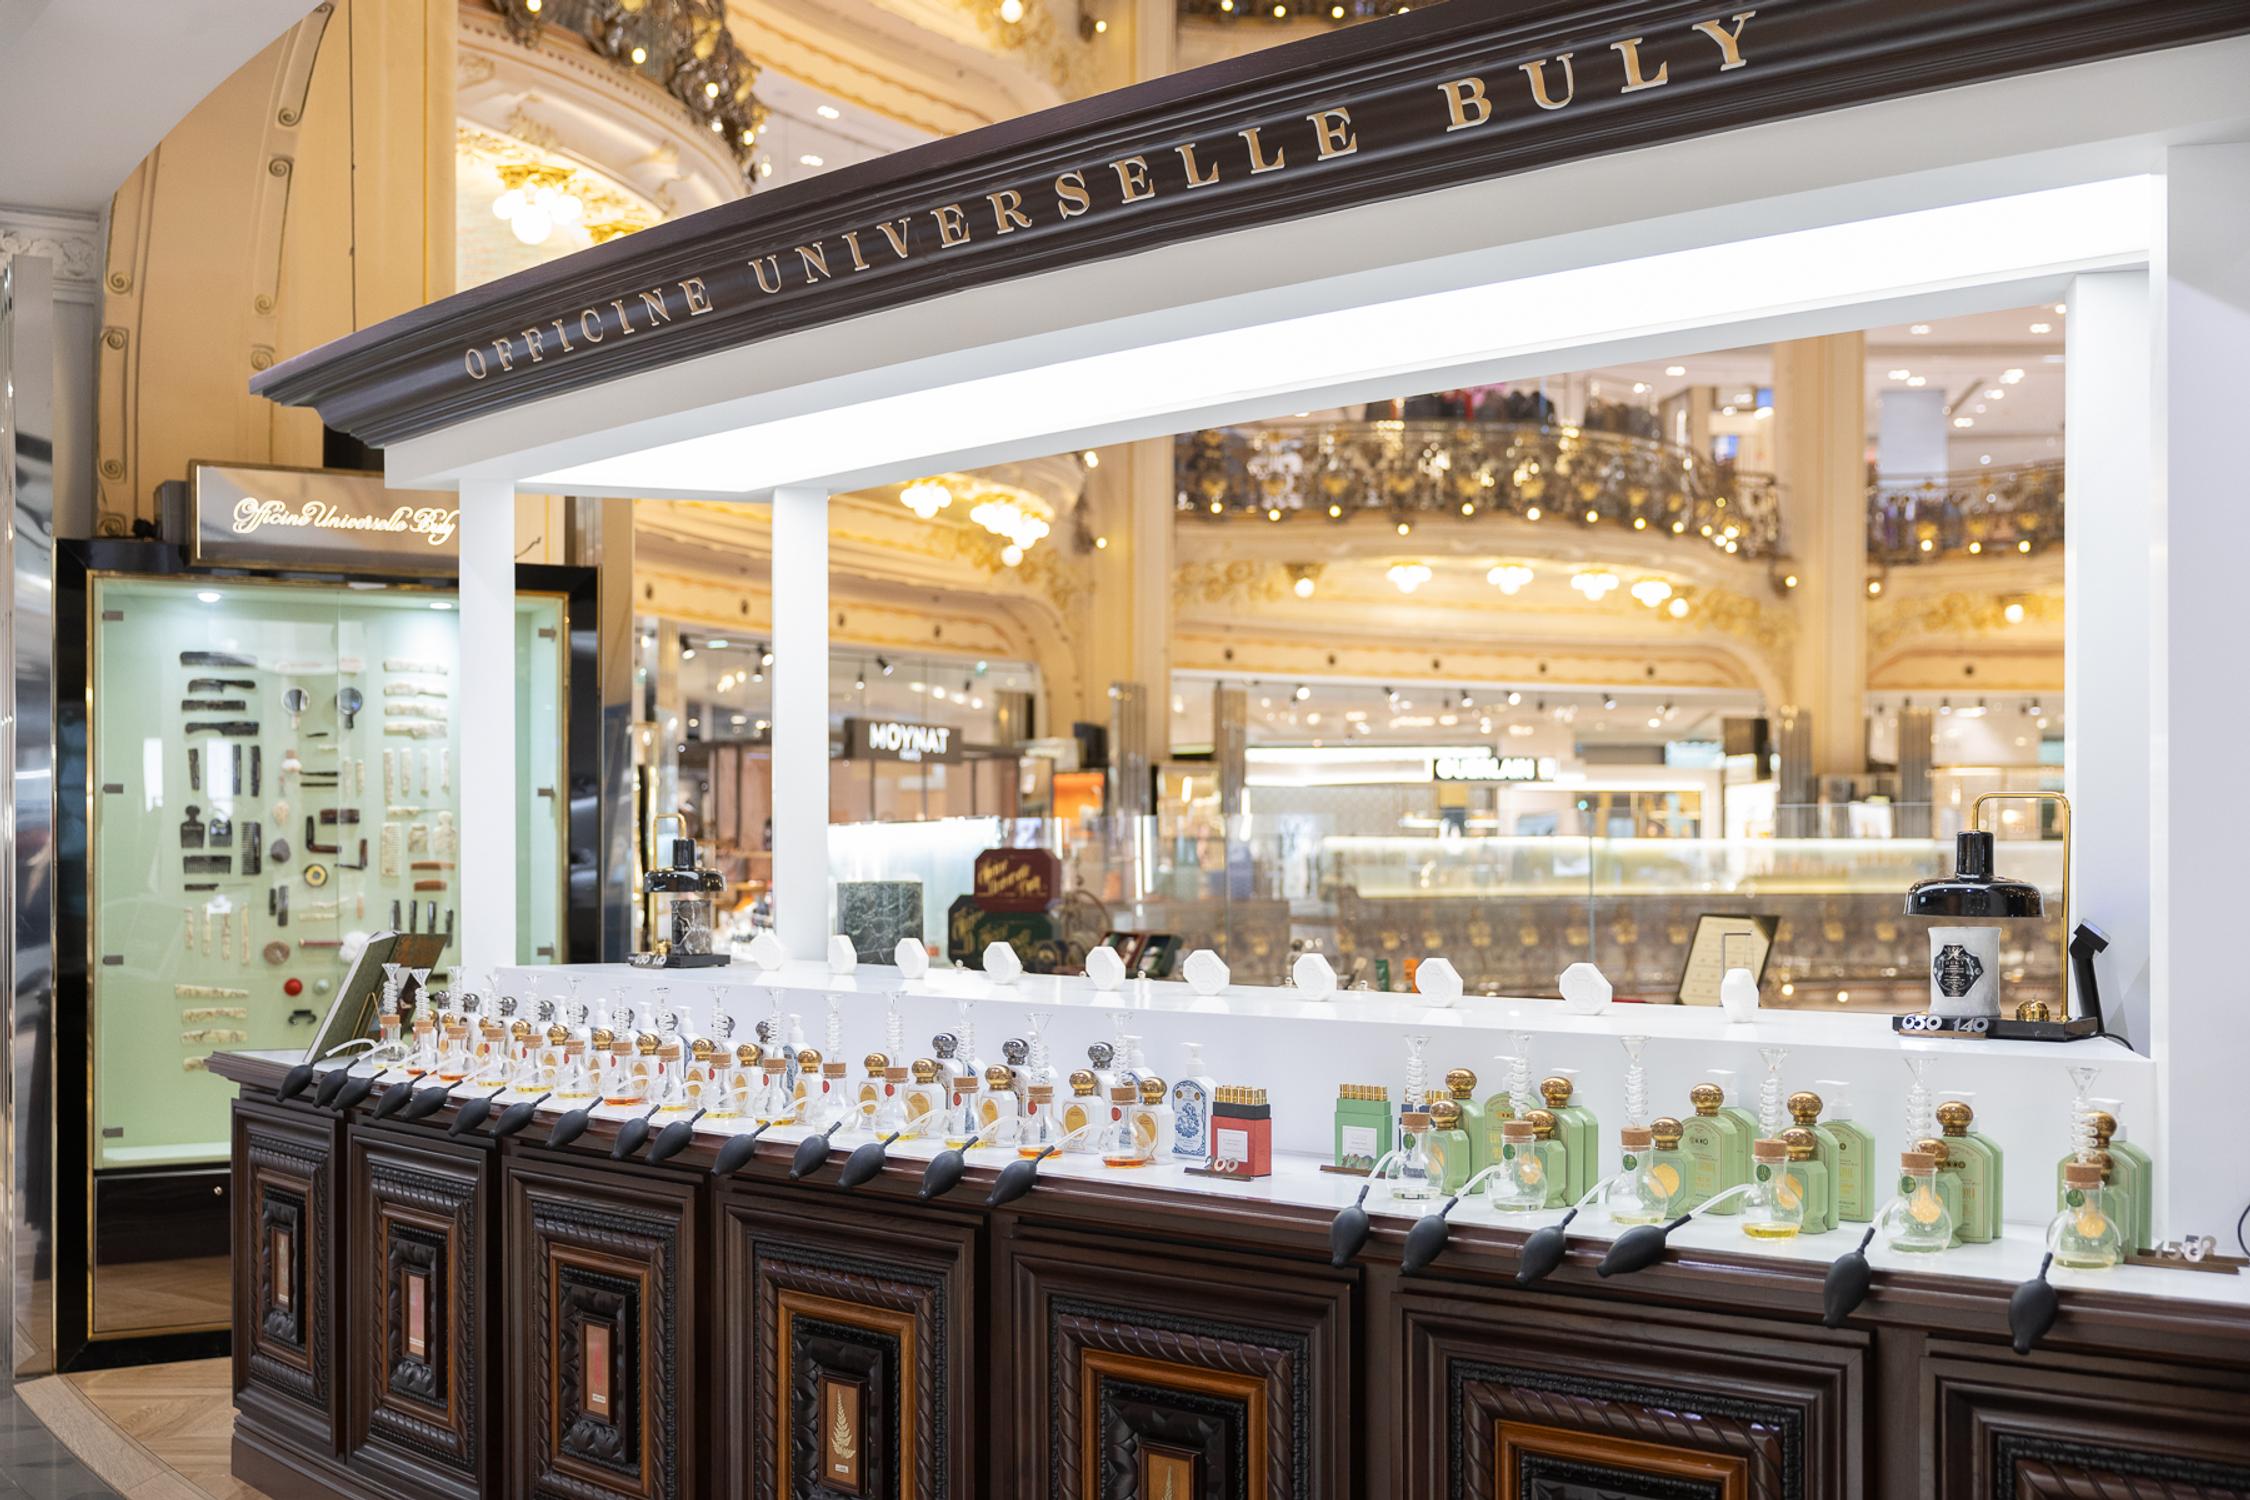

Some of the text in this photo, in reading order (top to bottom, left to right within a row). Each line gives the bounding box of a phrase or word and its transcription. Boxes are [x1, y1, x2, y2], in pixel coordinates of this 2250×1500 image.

[464, 10, 1757, 380] OFFICINE UNIVERSELLE BULY
[232, 497, 311, 535] Officine
[302, 500, 413, 533] Universelle
[868, 721, 951, 755] MOYNAT
[1901, 1013, 1989, 1033] 650 140
